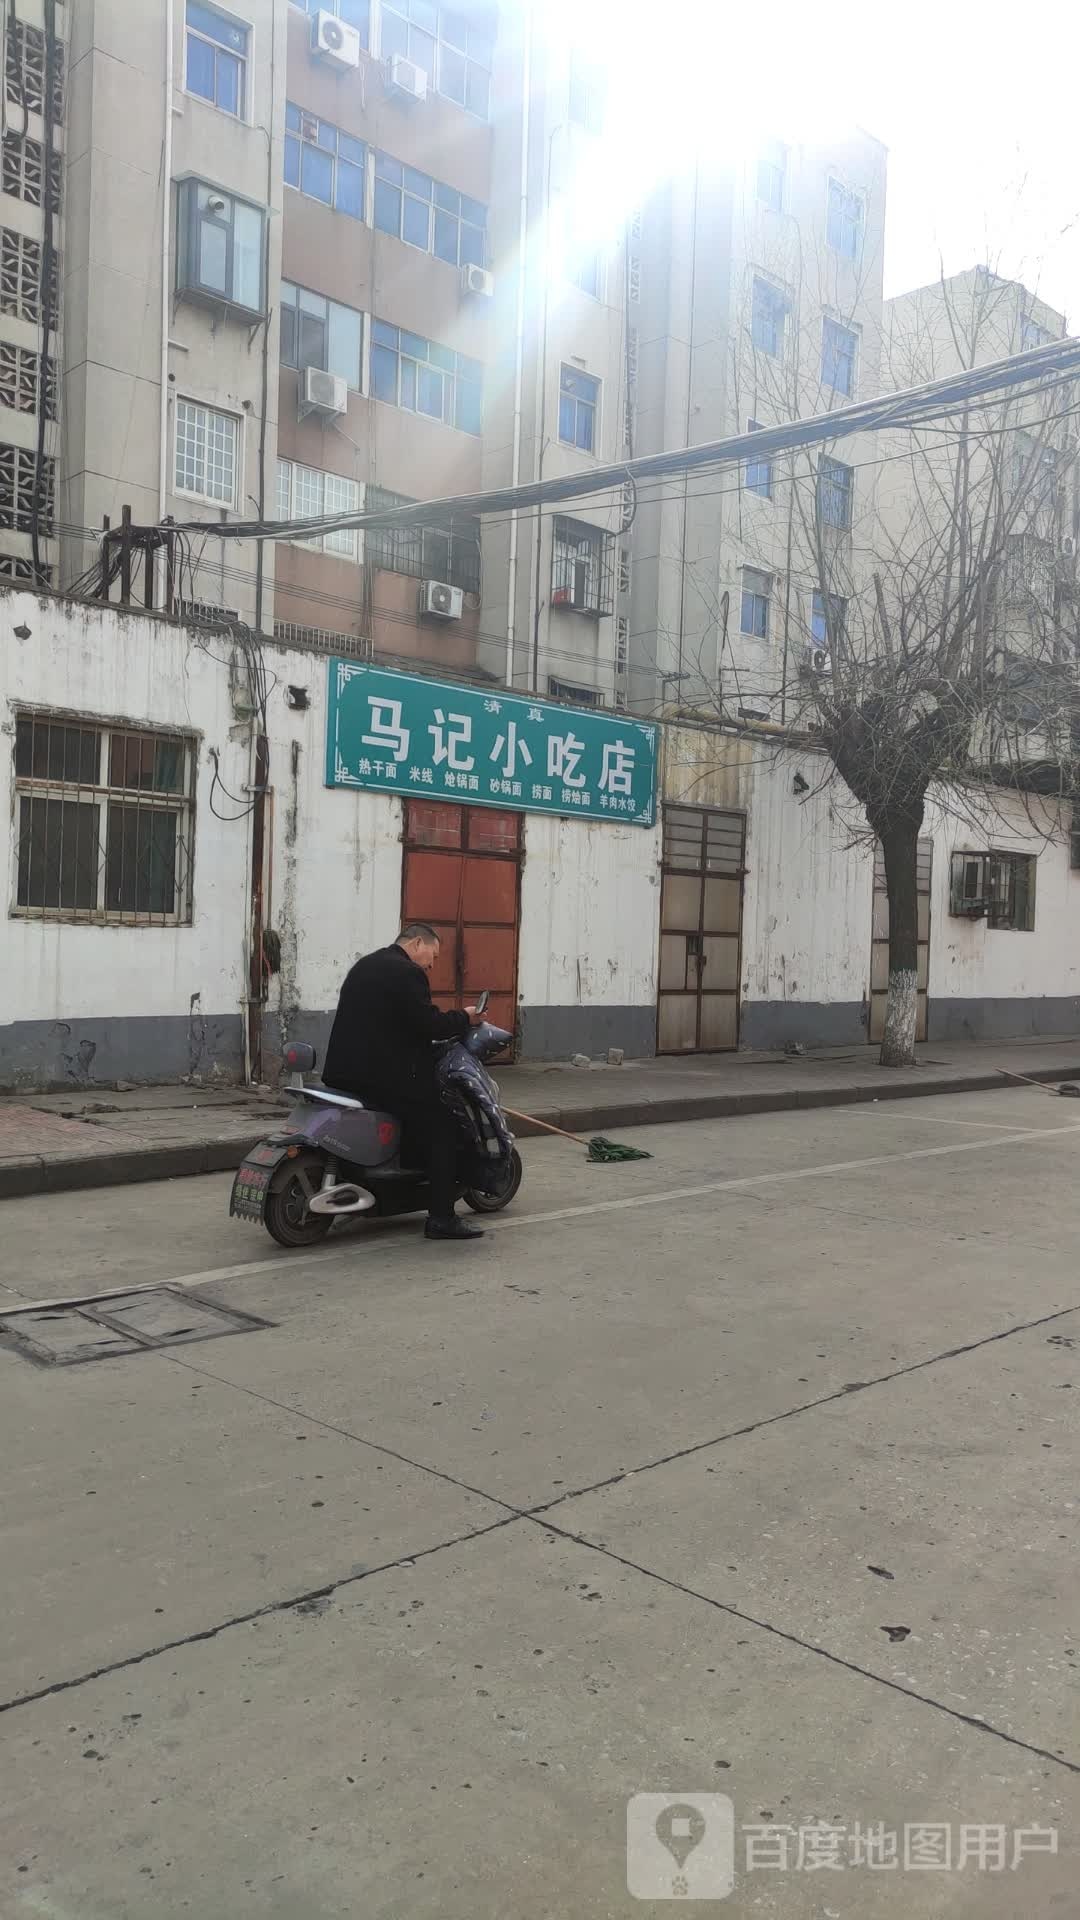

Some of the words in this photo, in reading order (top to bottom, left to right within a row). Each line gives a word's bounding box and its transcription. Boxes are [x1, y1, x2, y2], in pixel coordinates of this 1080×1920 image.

[483, 699, 545, 723] 清真
[361, 695, 636, 796] 马记小吃店
[358, 757, 398, 779] 热干面
[409, 765, 434, 784] 米线
[489, 778, 523, 797] 砂锅面
[532, 784, 553, 801] 捞面
[561, 788, 591, 806] 捞烩面
[599, 793, 636, 812] 羊肉水饺
